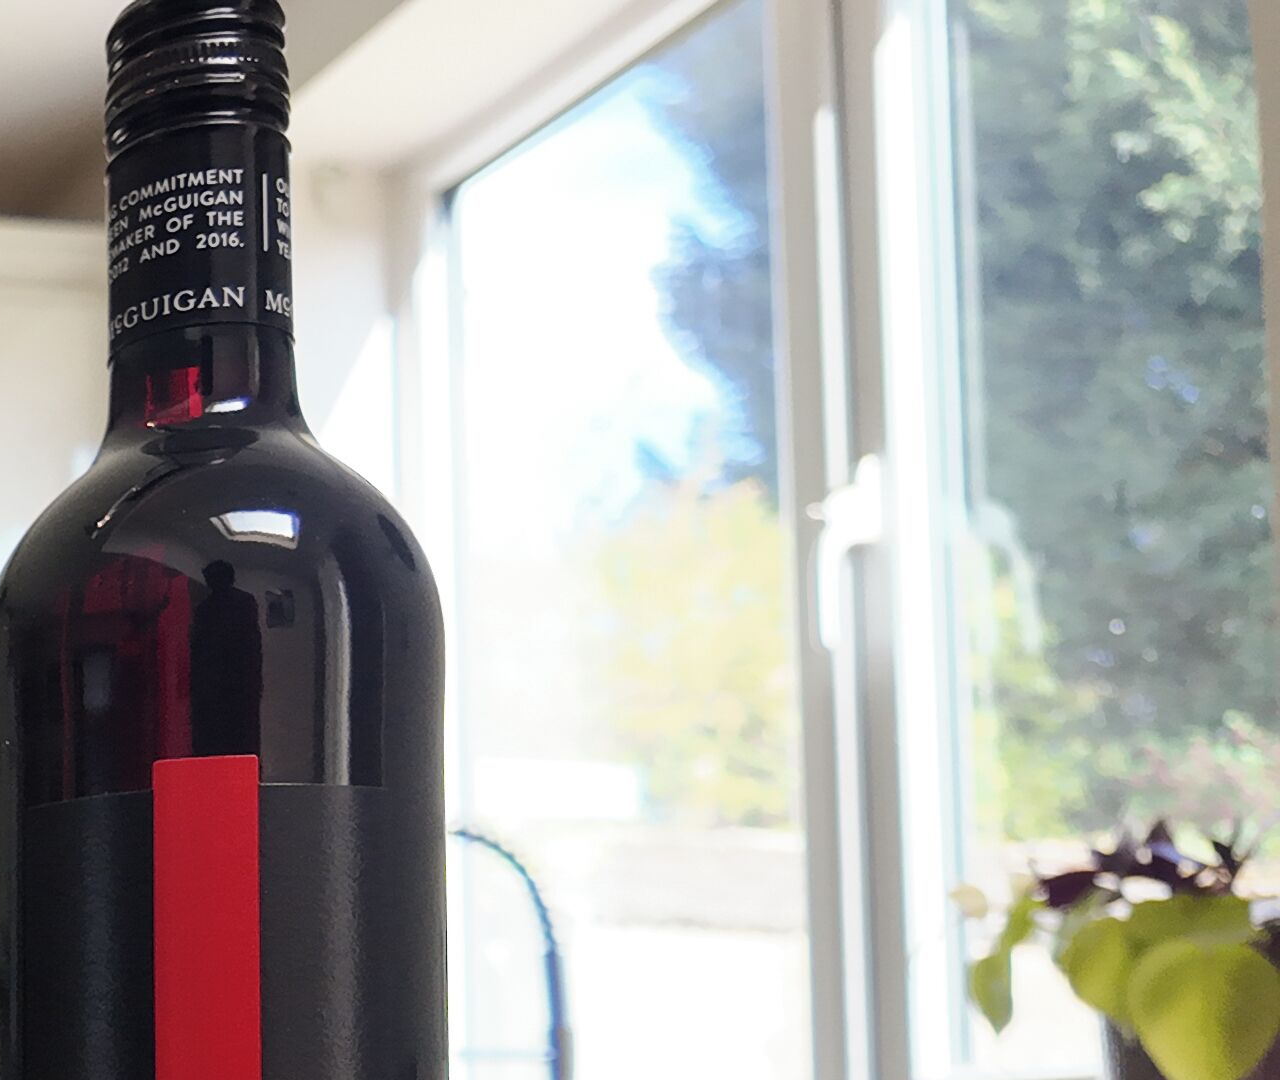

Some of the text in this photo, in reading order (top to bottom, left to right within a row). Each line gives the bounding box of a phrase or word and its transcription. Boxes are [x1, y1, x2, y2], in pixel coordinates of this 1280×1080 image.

[119, 168, 244, 211] COMMITMENT
[139, 190, 244, 222] McGUIGAN
[165, 213, 194, 233] OF
[206, 210, 244, 227] THE
[139, 238, 181, 264] AND
[195, 232, 244, 249] 2016.
